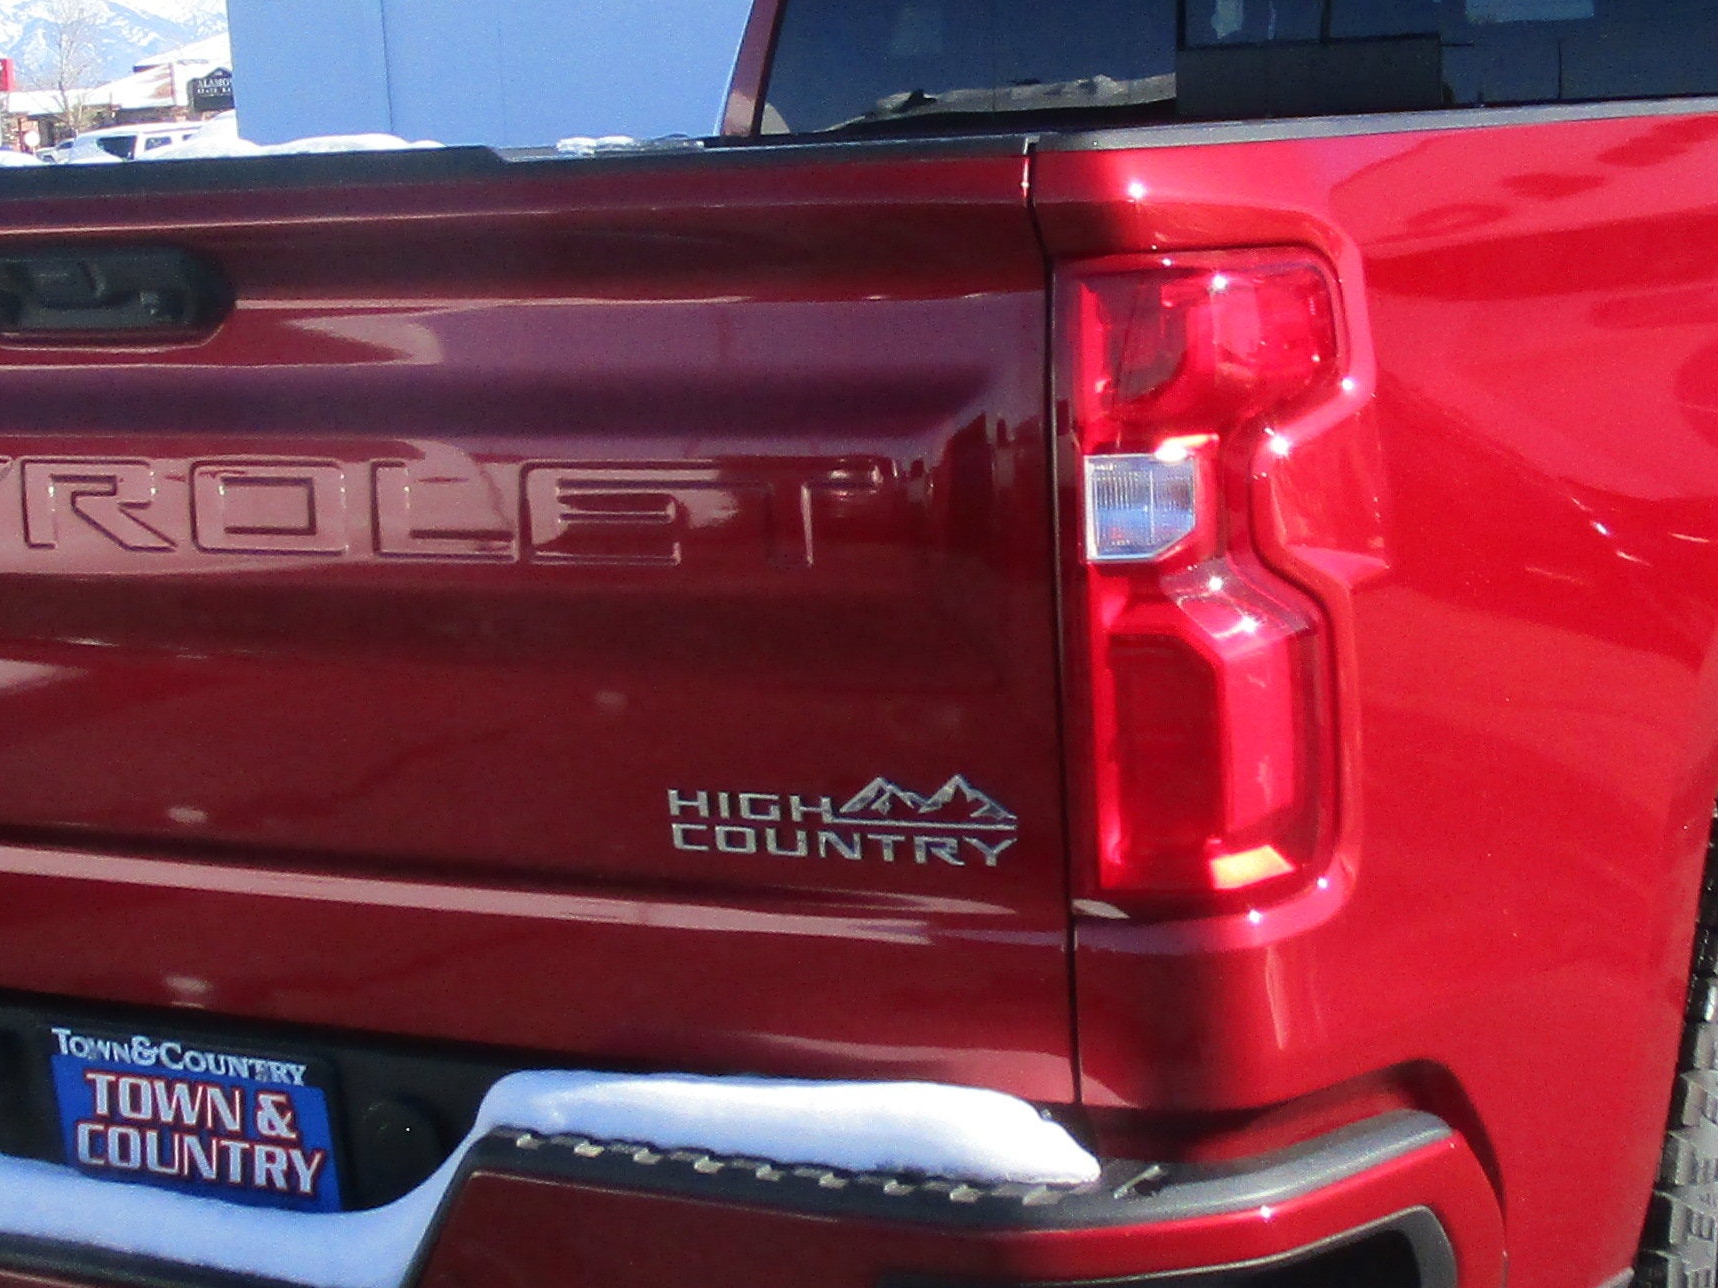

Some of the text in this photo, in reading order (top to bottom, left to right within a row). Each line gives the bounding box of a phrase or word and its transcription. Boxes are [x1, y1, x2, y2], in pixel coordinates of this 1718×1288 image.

[196, 77, 232, 88] ALAMO
[667, 788, 833, 825] HIGH
[671, 822, 1018, 868] COUNTRY
[84, 1071, 298, 1141] TOWN &
[75, 1121, 324, 1196] COUNTRY
